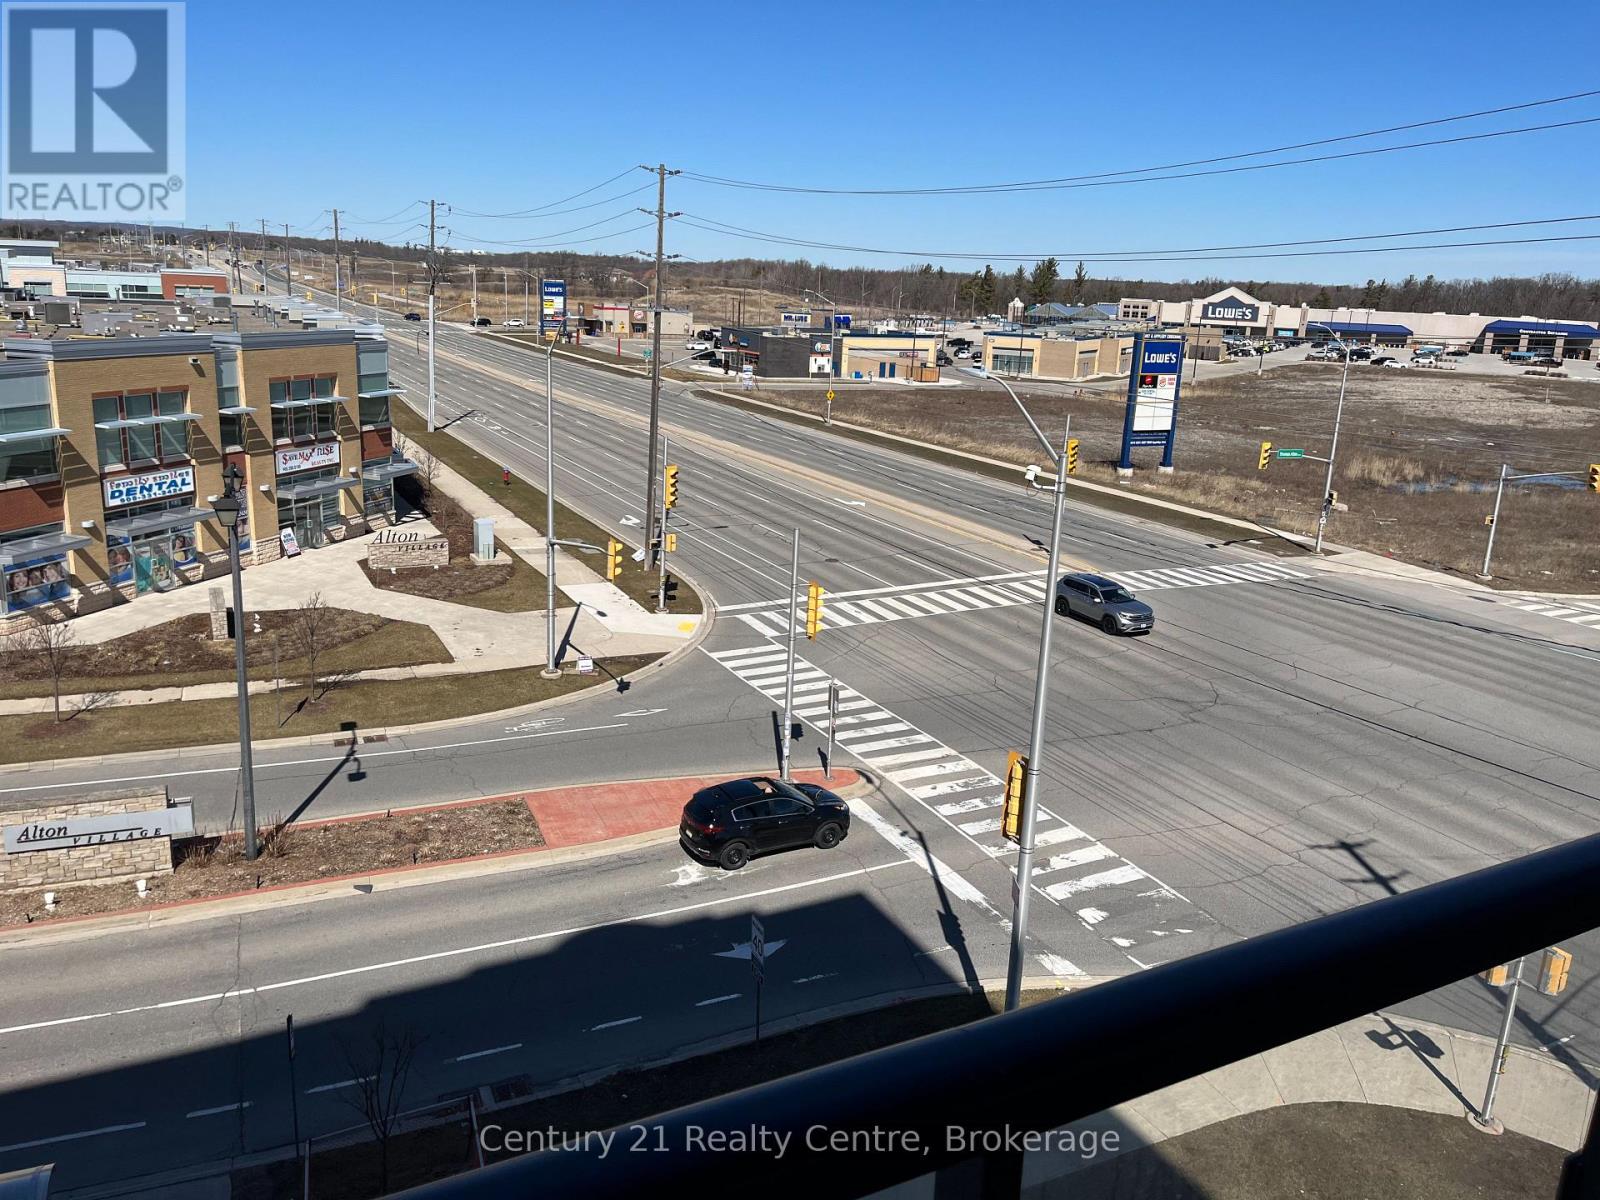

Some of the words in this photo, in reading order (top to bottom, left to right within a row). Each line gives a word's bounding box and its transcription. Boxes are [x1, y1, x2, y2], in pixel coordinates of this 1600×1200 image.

[1208, 305, 1253, 320] LOWE'S
[1144, 352, 1177, 364] LOWE'S
[110, 477, 149, 490] family
[152, 470, 190, 482] smiles
[110, 478, 191, 500] DENTAL
[371, 529, 419, 545] Alton
[398, 542, 448, 552] VILLAGE
[17, 825, 68, 841] Alton
[73, 827, 163, 845] VILLAGE
